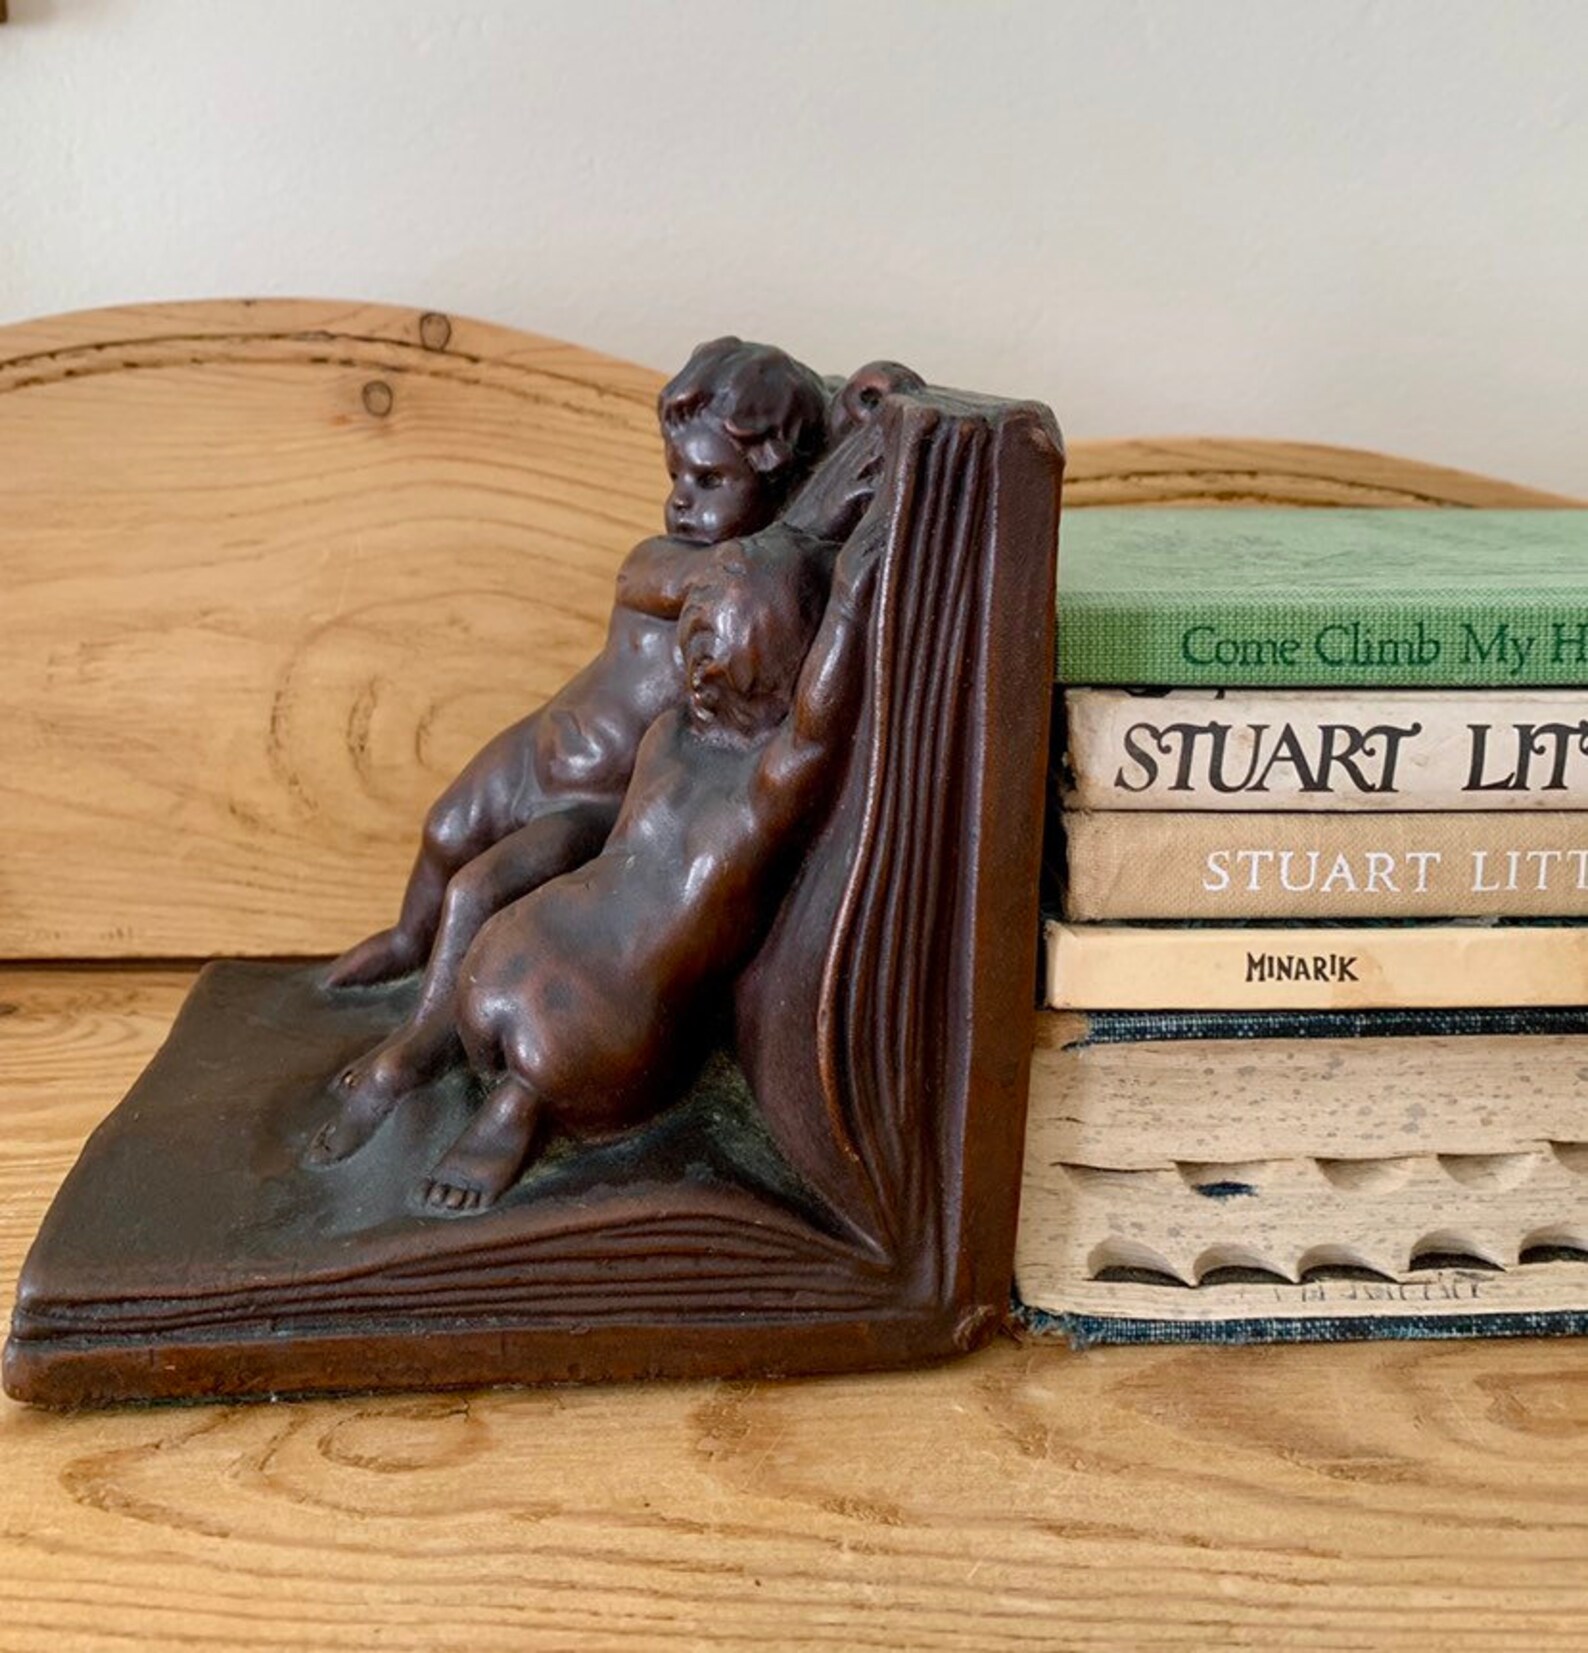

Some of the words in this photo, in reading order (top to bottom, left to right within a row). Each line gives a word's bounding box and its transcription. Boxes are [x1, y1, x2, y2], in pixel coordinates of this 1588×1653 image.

[1181, 625, 1301, 666] Come
[1315, 621, 1441, 667] Climb
[1460, 622, 1535, 675] My
[1114, 720, 1422, 793] STUART
[1461, 719, 1588, 791] LIT
[1202, 850, 1441, 893] STUART
[1245, 951, 1360, 982] MINARIK
